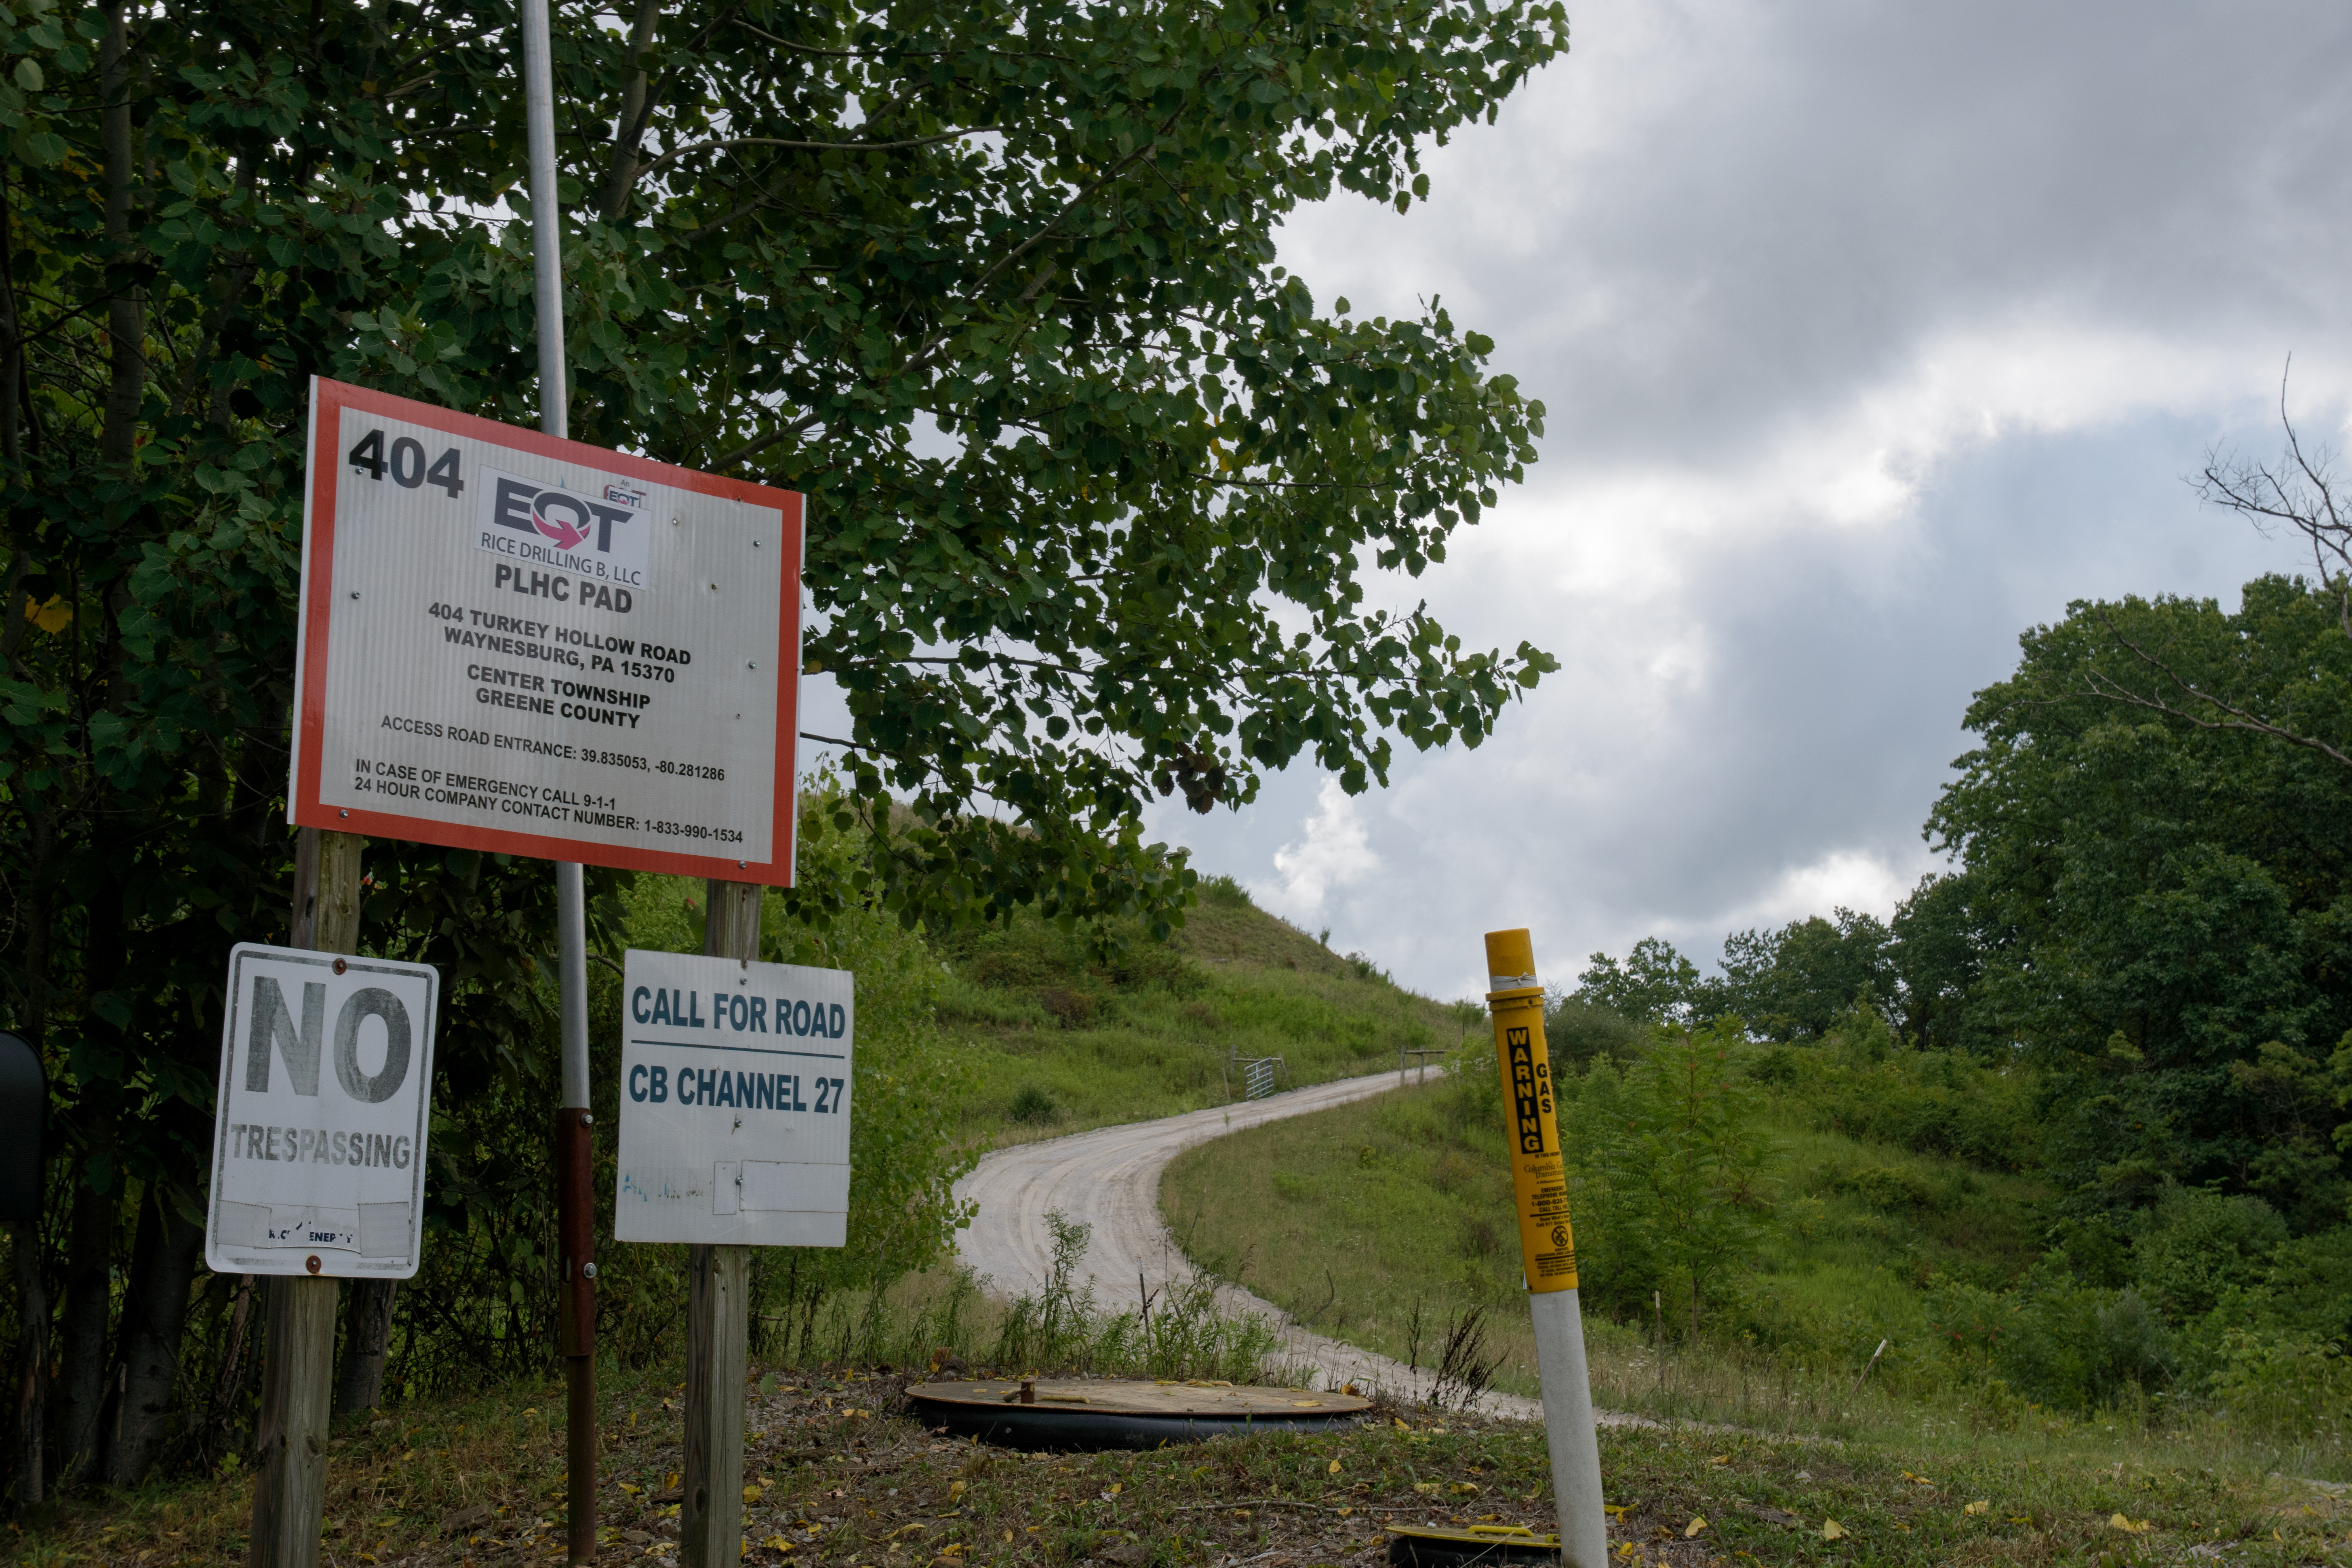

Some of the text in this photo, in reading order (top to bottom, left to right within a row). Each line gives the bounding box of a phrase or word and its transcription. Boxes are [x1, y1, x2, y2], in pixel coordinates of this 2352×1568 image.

[348, 429, 464, 499] 404
[621, 479, 630, 487] An
[494, 477, 634, 553] EQT
[609, 490, 639, 507] EQT
[481, 532, 641, 586] RICE DRILLING B, LLC
[495, 563, 632, 613] PLHC PAD
[428, 602, 691, 665] 404 TURKEY HOLLOW ROAD
[444, 626, 675, 683] WAYNESBURG, PA 15370
[467, 664, 651, 709] CENTER TOWNSHIP
[476, 688, 640, 729] GREENE COUNTY
[381, 715, 725, 781] ACCESS ROAD ENTRANCE: 39.835053, -80.281286
[354, 777, 743, 843] 24 HOUR COMPANY CONTACT NUMBER: 1-833-990-1534
[356, 758, 615, 810] IN CASE OF EMERGENCY CALL 9-1-1
[632, 986, 845, 1039] CALL FOR ROAD
[245, 975, 411, 1103] NO
[629, 1064, 844, 1114] CB CHANNEL 27
[1508, 1029, 1540, 1151] WARNING
[1536, 1063, 1552, 1113] GAS
[230, 1123, 410, 1169] TRESPASSING
[1524, 1162, 1555, 1172] Columbia
